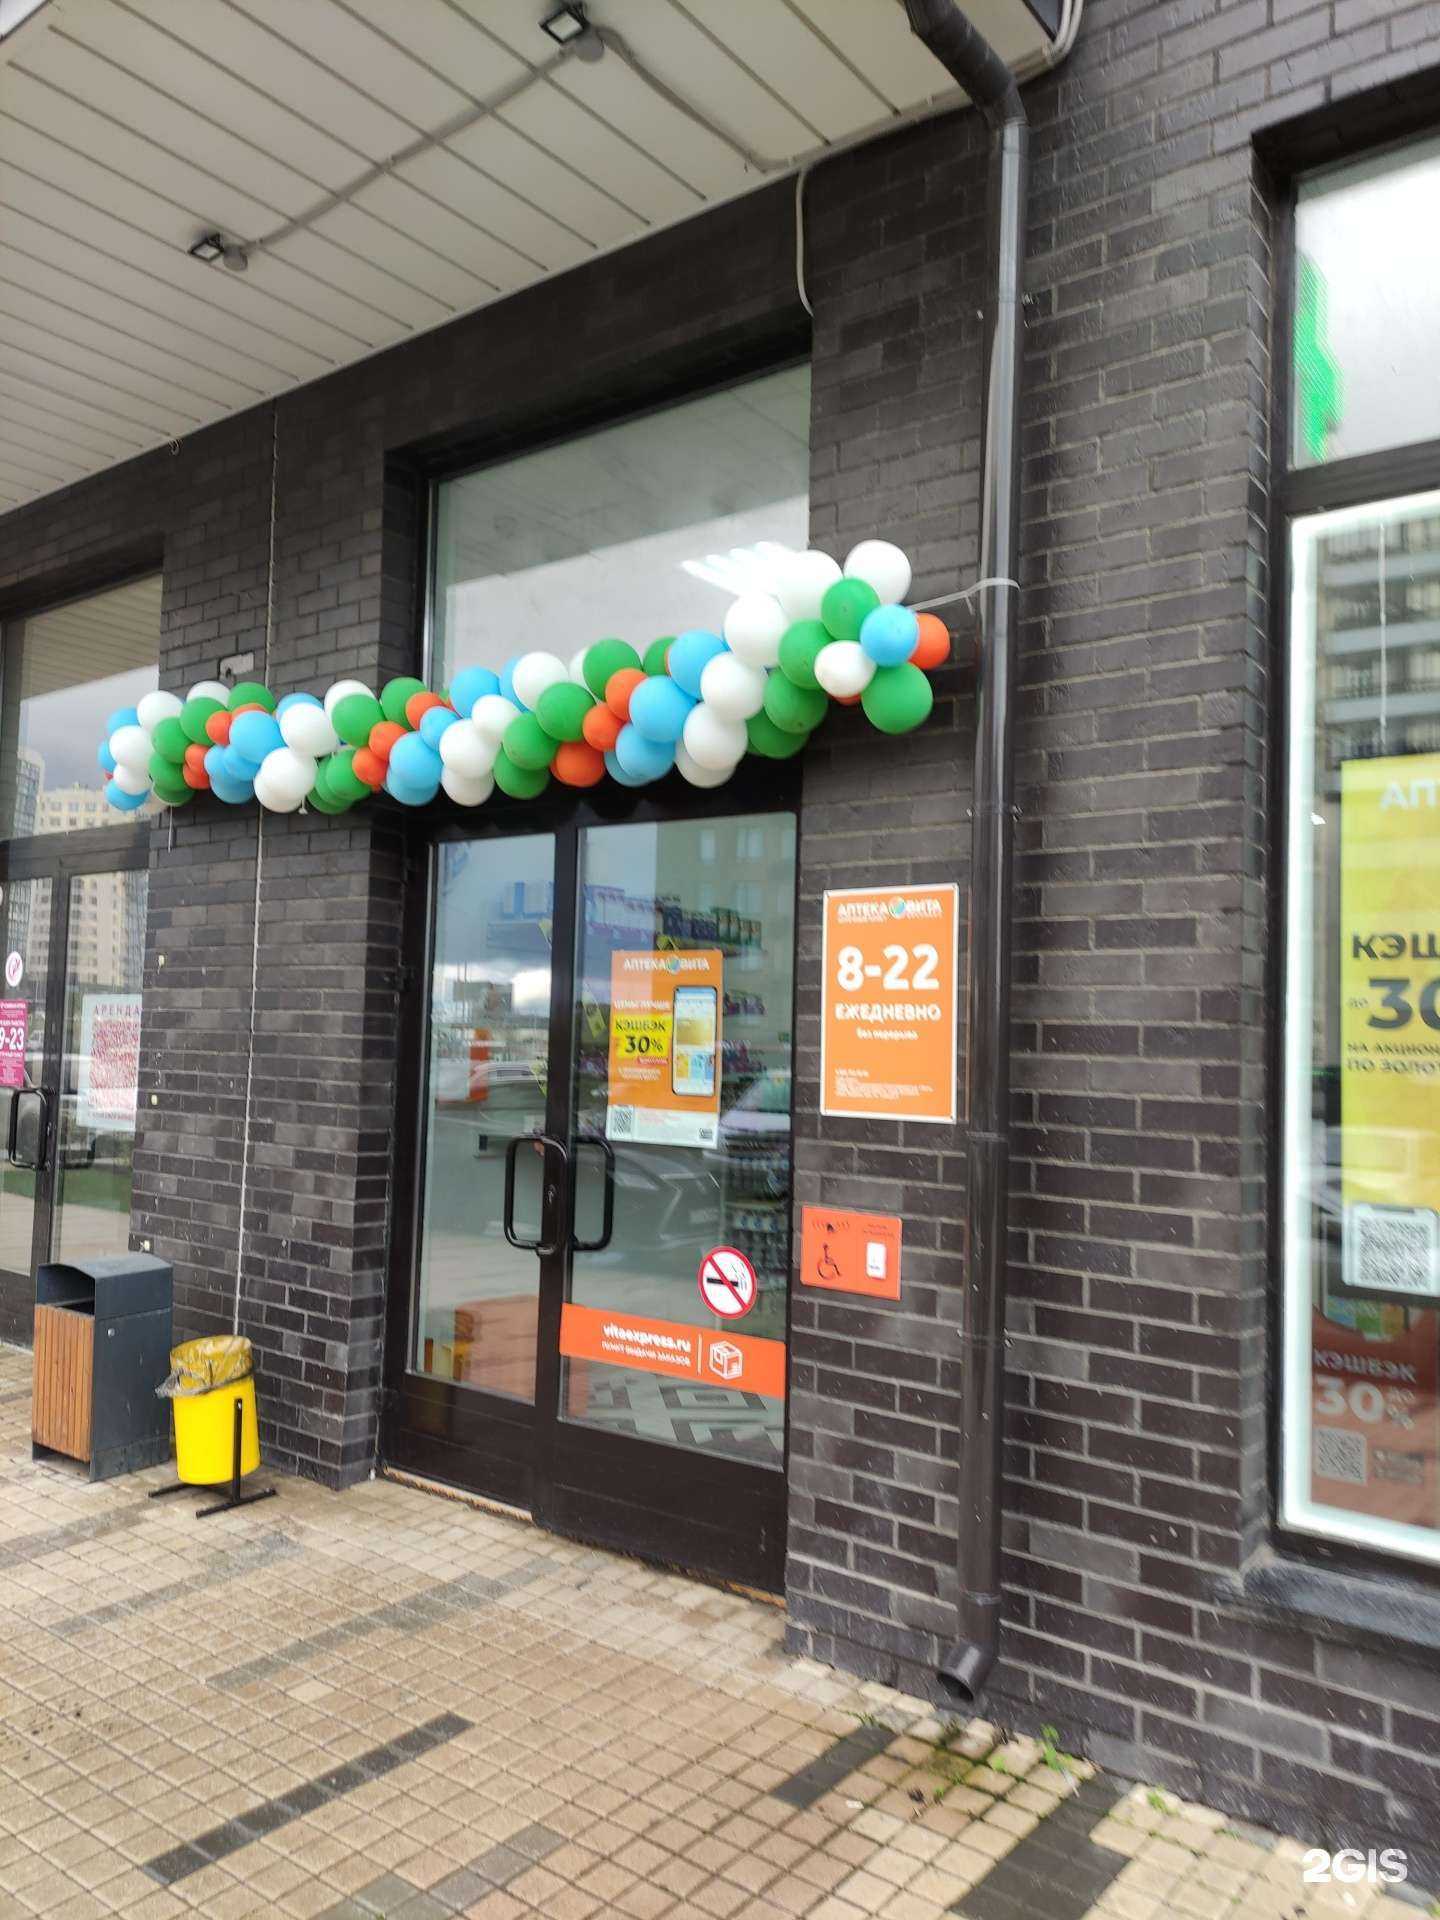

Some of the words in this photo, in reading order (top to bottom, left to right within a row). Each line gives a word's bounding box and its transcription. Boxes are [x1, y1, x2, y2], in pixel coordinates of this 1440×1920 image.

[837, 901, 889, 918] АПТЕКА
[623, 957, 666, 972] АПТЕКА
[836, 943, 940, 992] 8-22
[94, 1003, 141, 1017] АРЕНДА
[835, 1002, 941, 1024] ЕЖЕДНЕВНО
[602, 1322, 692, 1353] vitaexpress.ru
